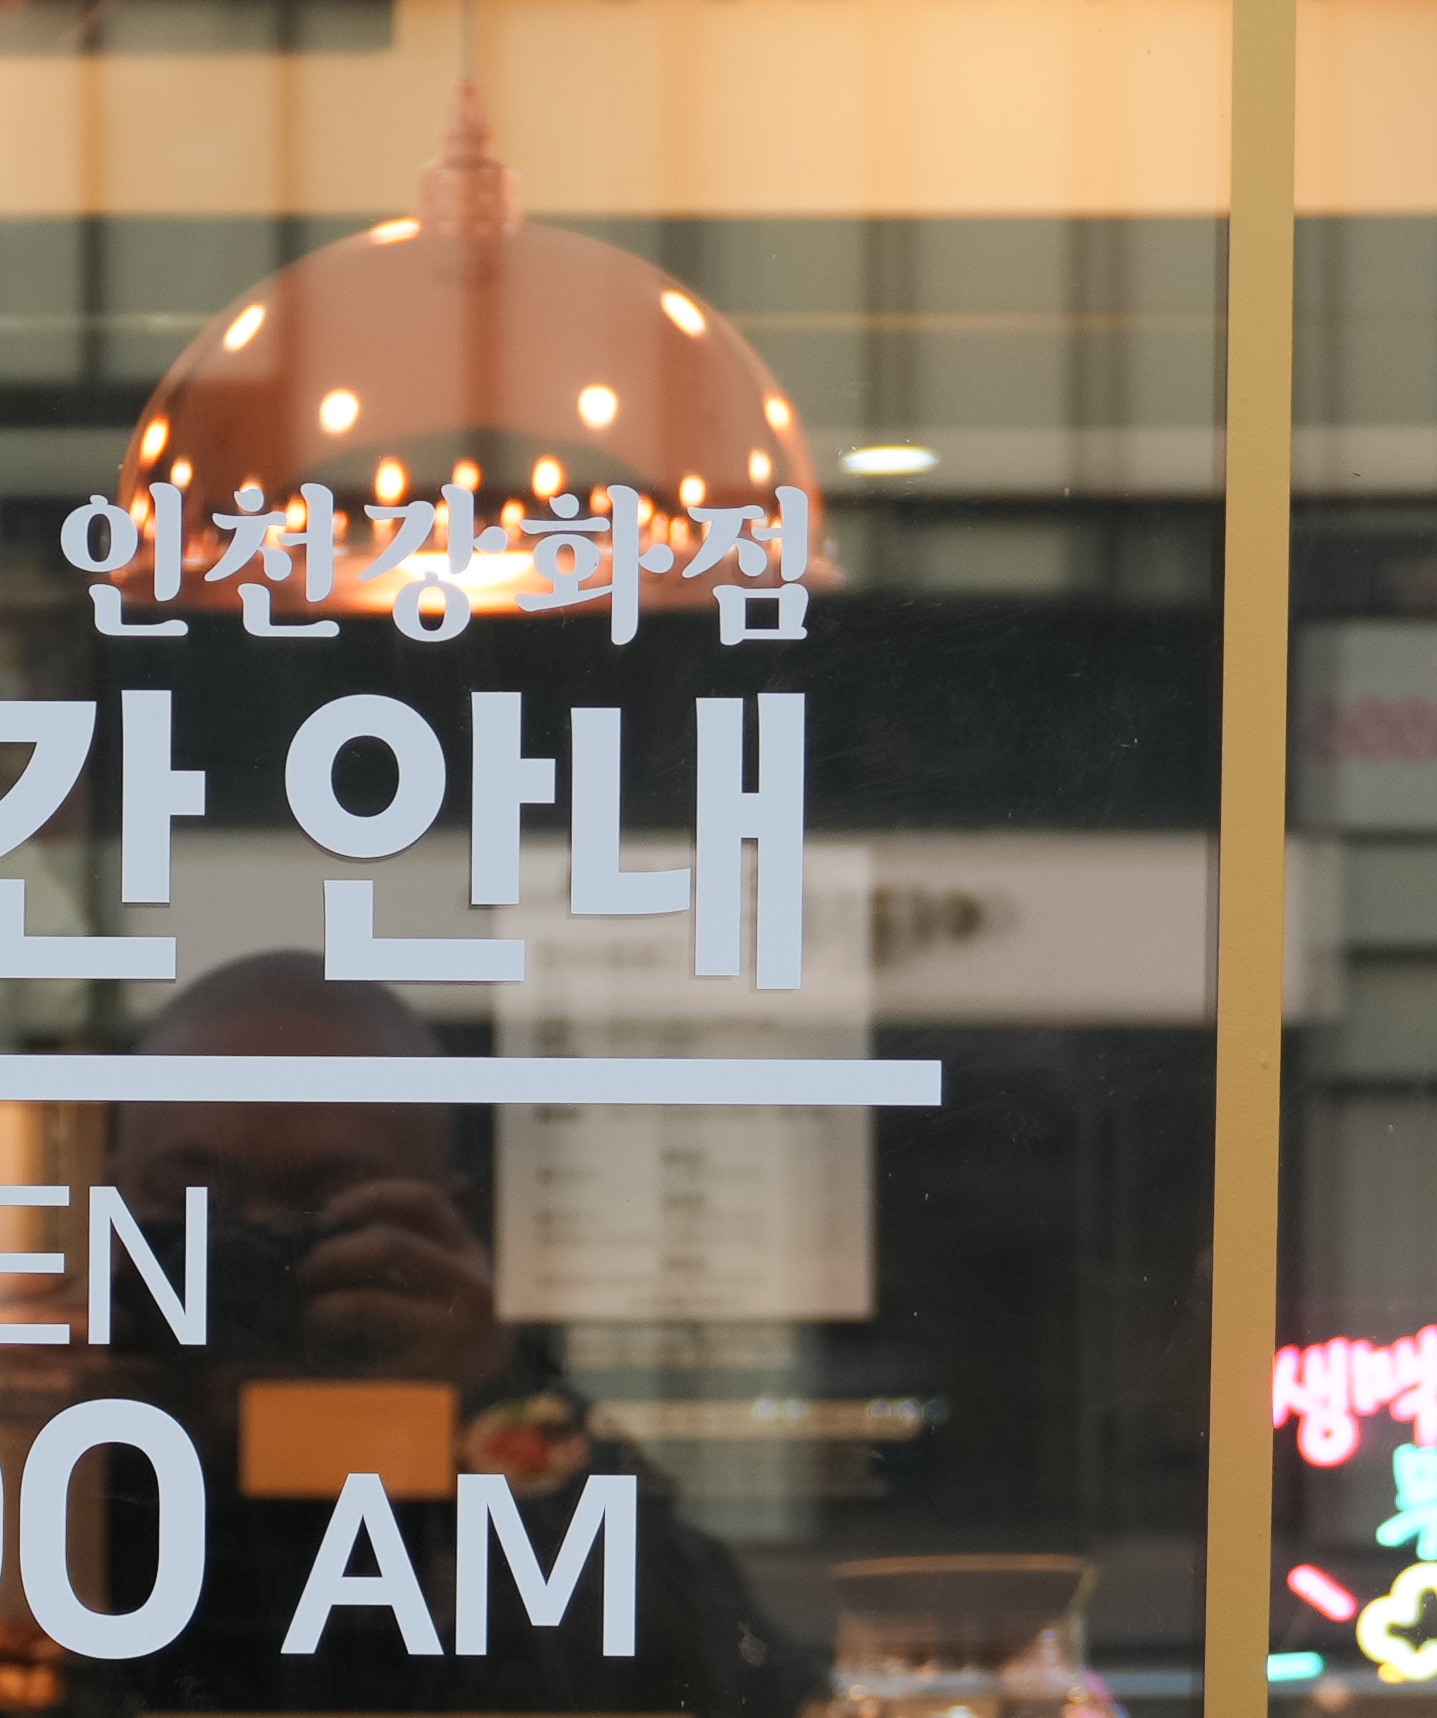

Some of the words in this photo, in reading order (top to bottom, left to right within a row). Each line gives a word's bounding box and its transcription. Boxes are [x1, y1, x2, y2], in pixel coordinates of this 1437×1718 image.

[60, 480, 811, 647] 인천강화점
[284, 690, 806, 990] 안내
[280, 1472, 638, 1658] AM
